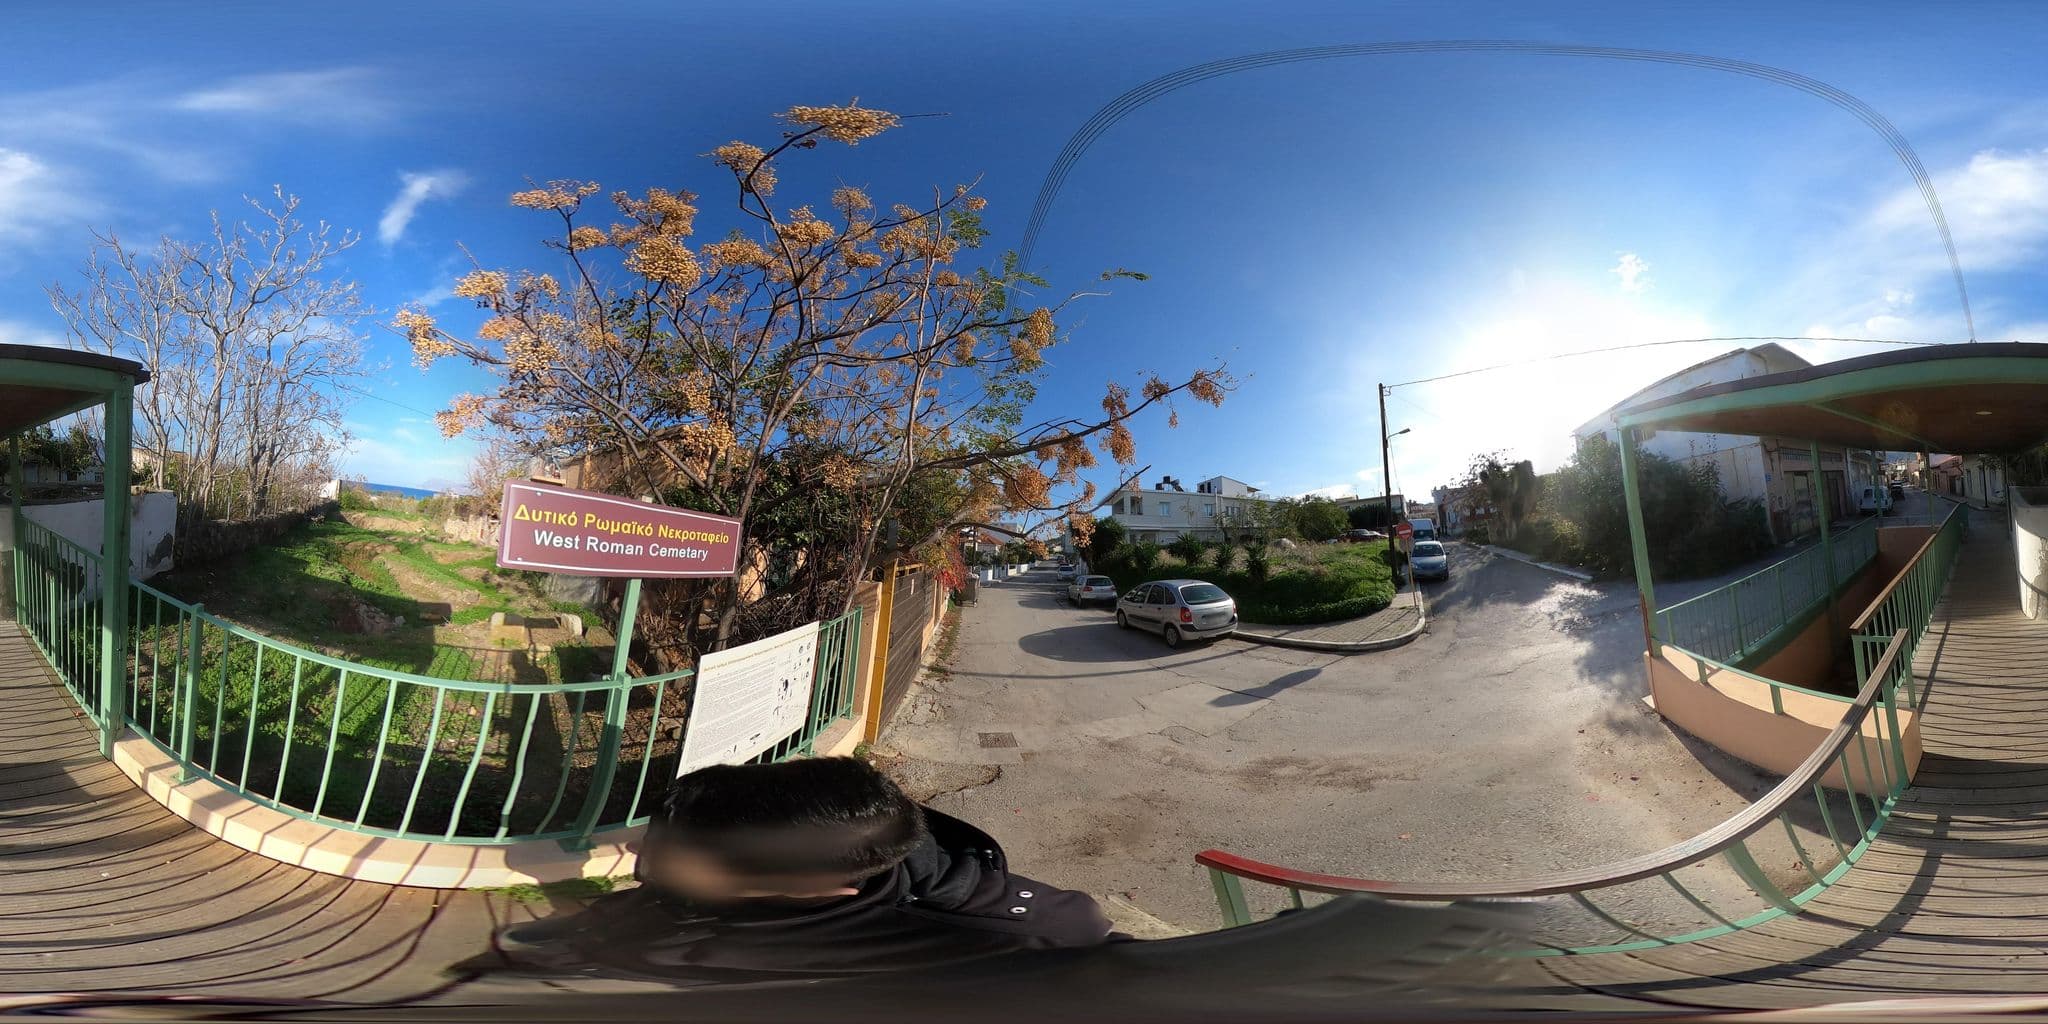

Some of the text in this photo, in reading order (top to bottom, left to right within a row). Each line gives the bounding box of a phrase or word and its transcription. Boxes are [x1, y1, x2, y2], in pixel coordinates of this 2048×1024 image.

[514, 504, 729, 544] Δυτικό Ρωμαϊκό Νεκροταφείο
[534, 529, 708, 561] West Roman Cemetary
